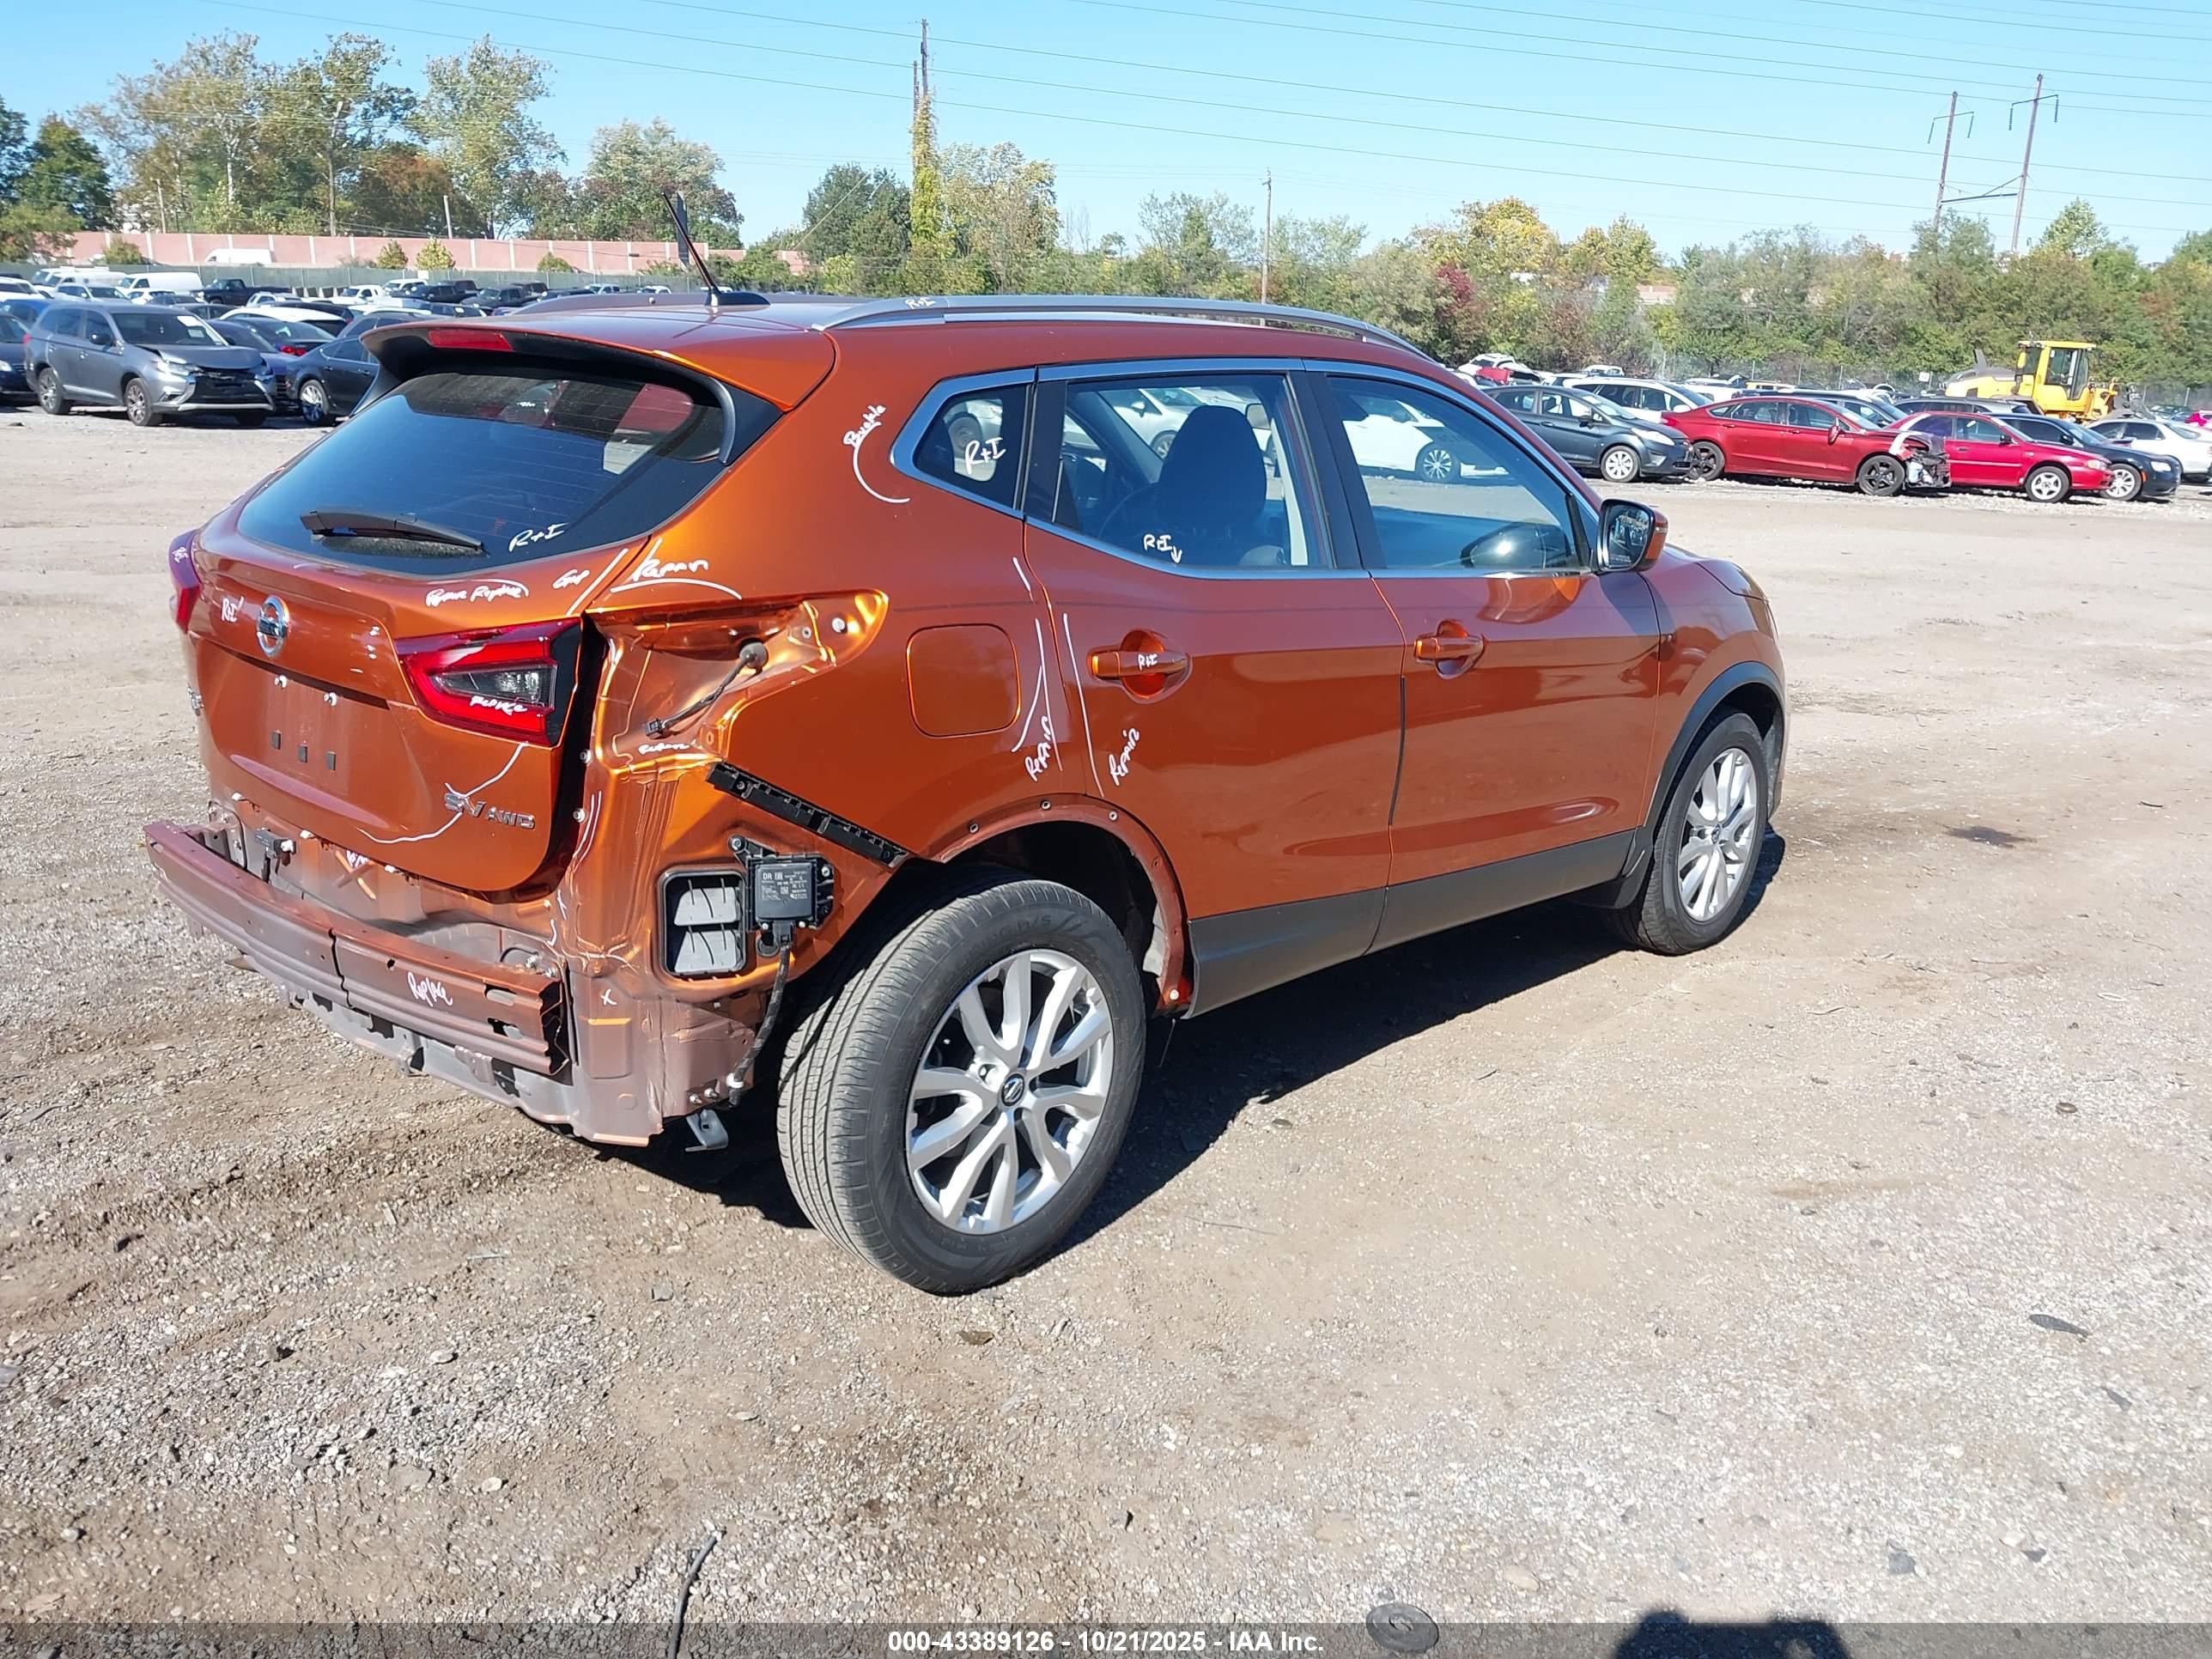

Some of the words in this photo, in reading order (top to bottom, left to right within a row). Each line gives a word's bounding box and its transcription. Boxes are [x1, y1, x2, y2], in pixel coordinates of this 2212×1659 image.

[964, 437, 1006, 475] R+I
[508, 522, 569, 552] R+I
[487, 805, 537, 830] AWD
